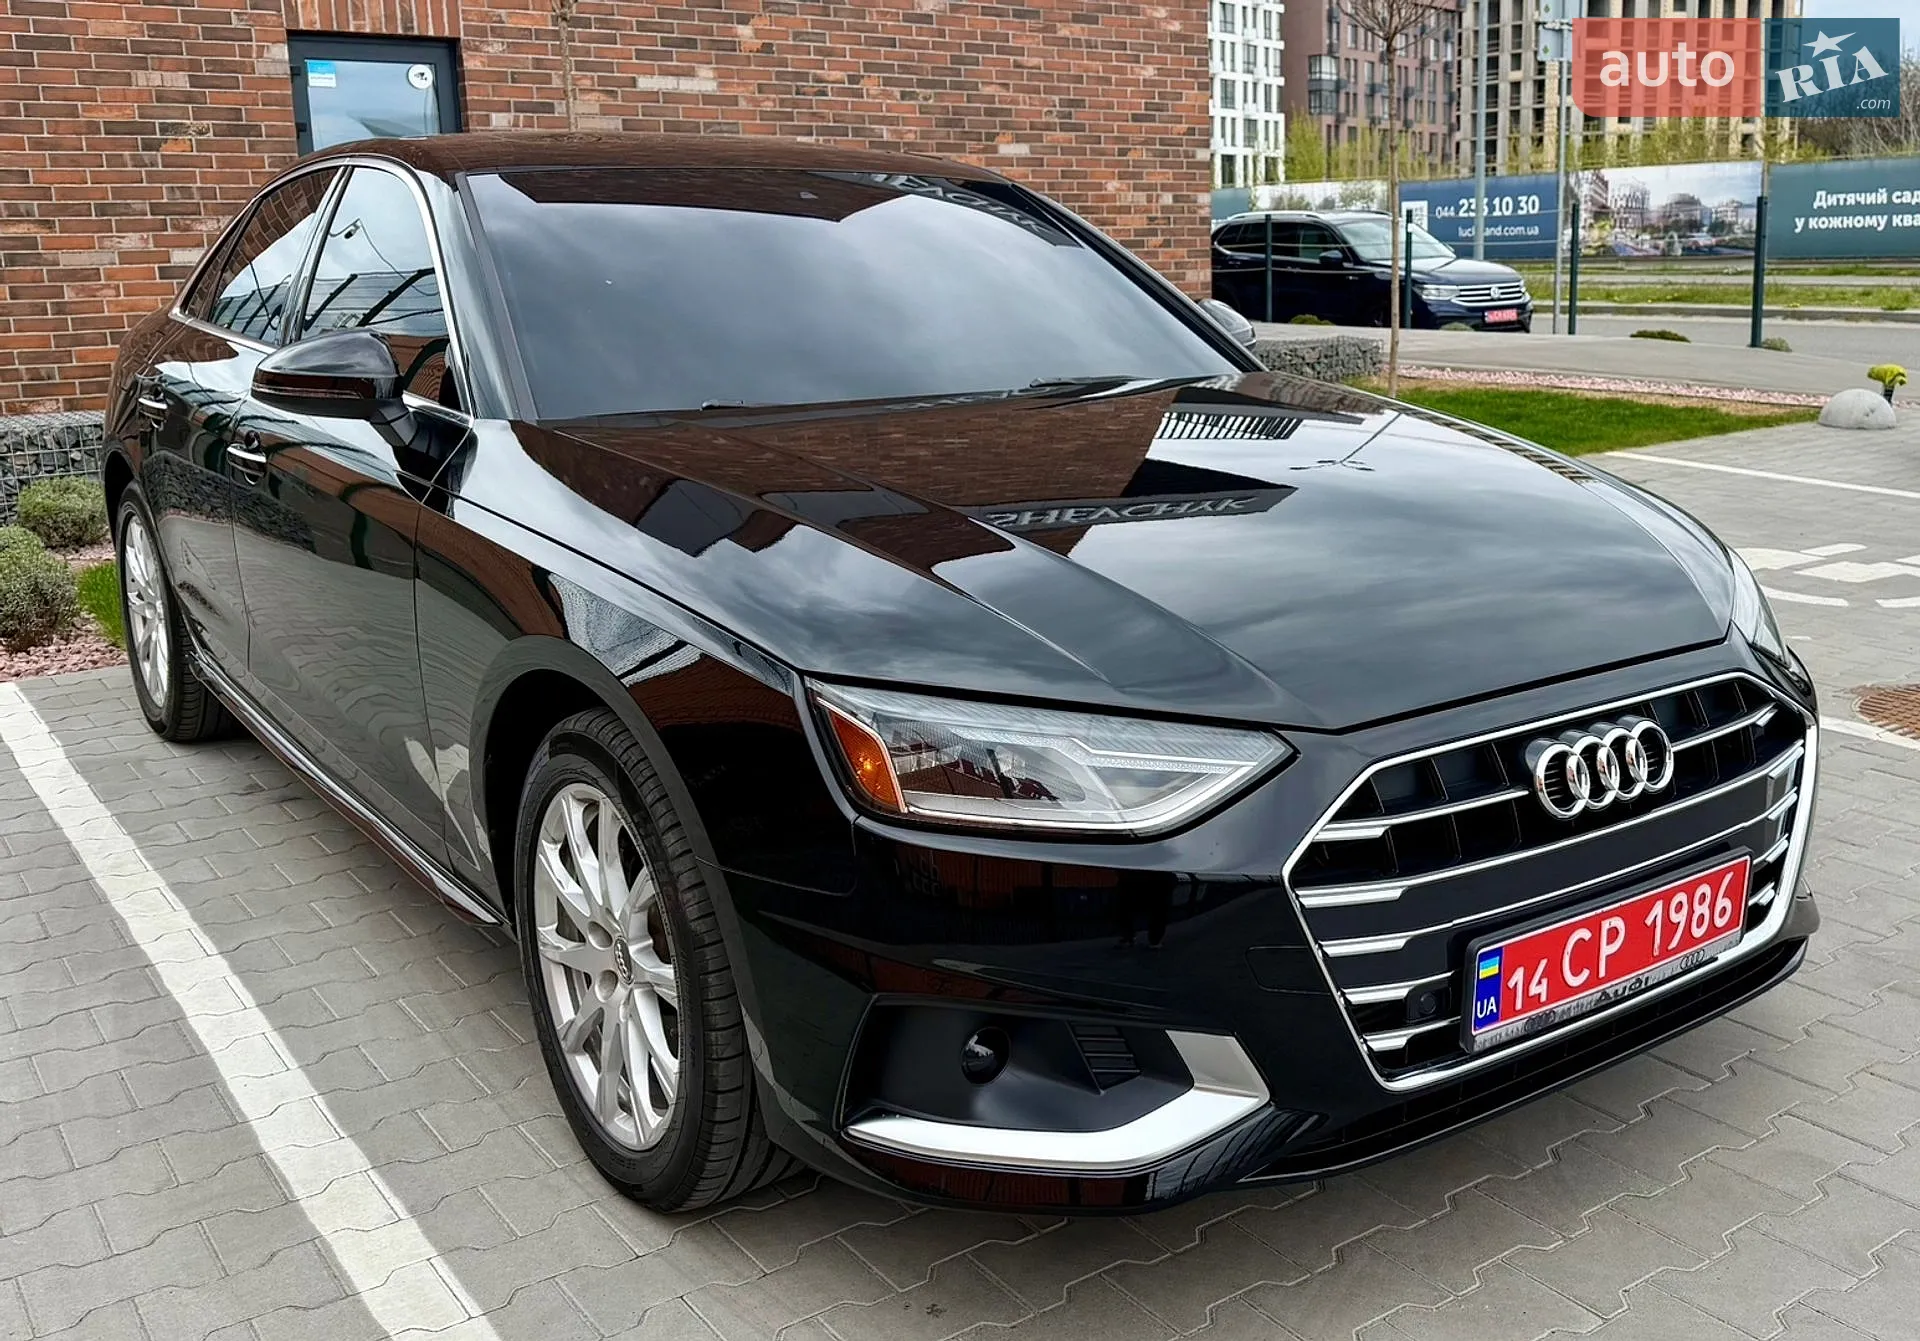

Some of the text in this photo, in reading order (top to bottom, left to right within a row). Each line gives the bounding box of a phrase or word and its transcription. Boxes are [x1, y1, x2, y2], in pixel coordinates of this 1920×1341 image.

[1436, 205, 1455, 219] 044
[1492, 196, 1513, 216] 10
[1517, 194, 1540, 215] 30
[1813, 187, 1920, 209] Дитячий сад
[1794, 213, 1920, 233] у кожному ква
[1507, 871, 1734, 1011] 14 CP 1986
[1476, 996, 1498, 1018] UA
